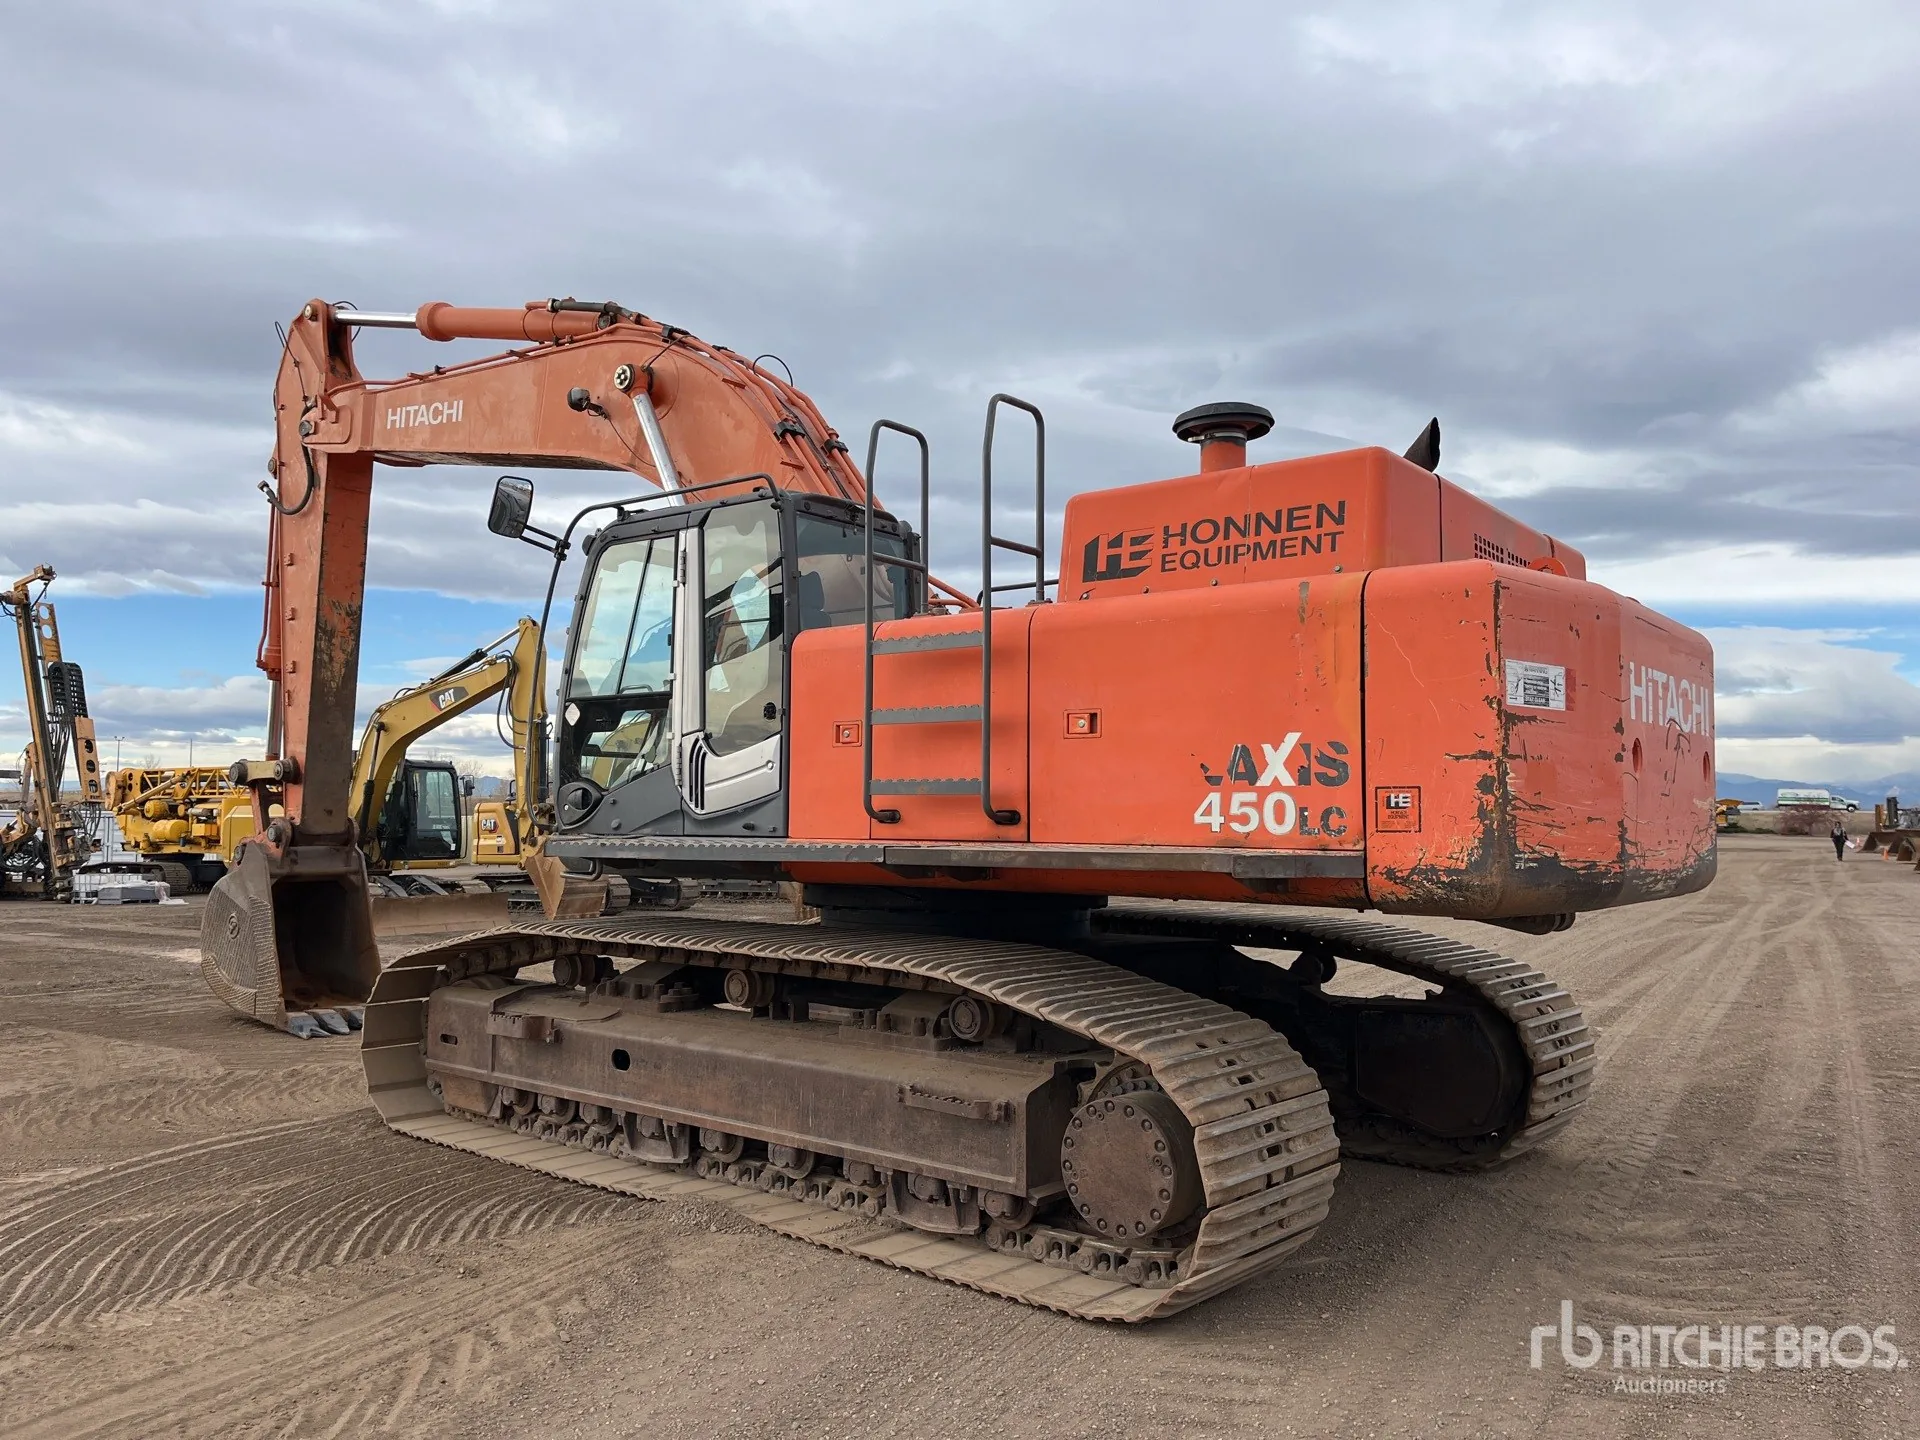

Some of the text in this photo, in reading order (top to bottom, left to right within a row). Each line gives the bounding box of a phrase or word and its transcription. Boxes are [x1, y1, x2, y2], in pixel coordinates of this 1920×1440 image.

[386, 400, 464, 430] HITACHI
[1161, 500, 1347, 550] HONNEN
[1160, 530, 1345, 573] EQUIPMENT
[438, 688, 456, 709] CAT
[1629, 661, 1710, 737] HITACHI
[481, 819, 496, 831] CAT
